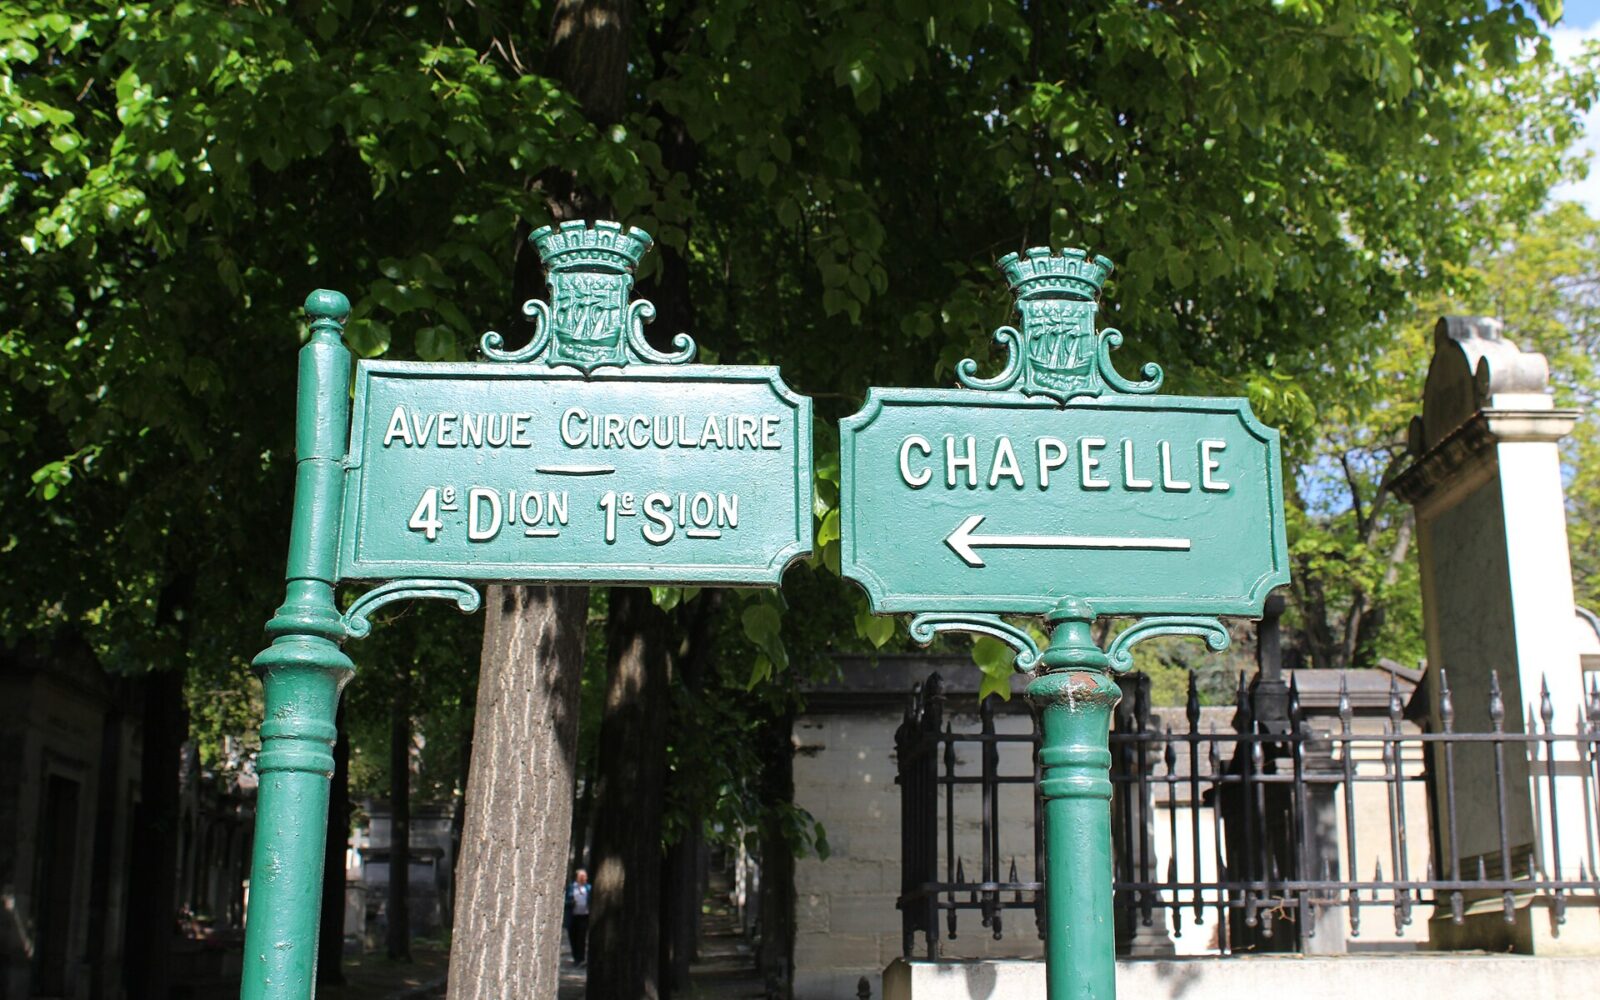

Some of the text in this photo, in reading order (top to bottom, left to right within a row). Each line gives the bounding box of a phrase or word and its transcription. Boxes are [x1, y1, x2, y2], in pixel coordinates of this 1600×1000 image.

[384, 406, 782, 449] AVENUE CIRCULAIRE
[899, 435, 1231, 492] CHAPELLE
